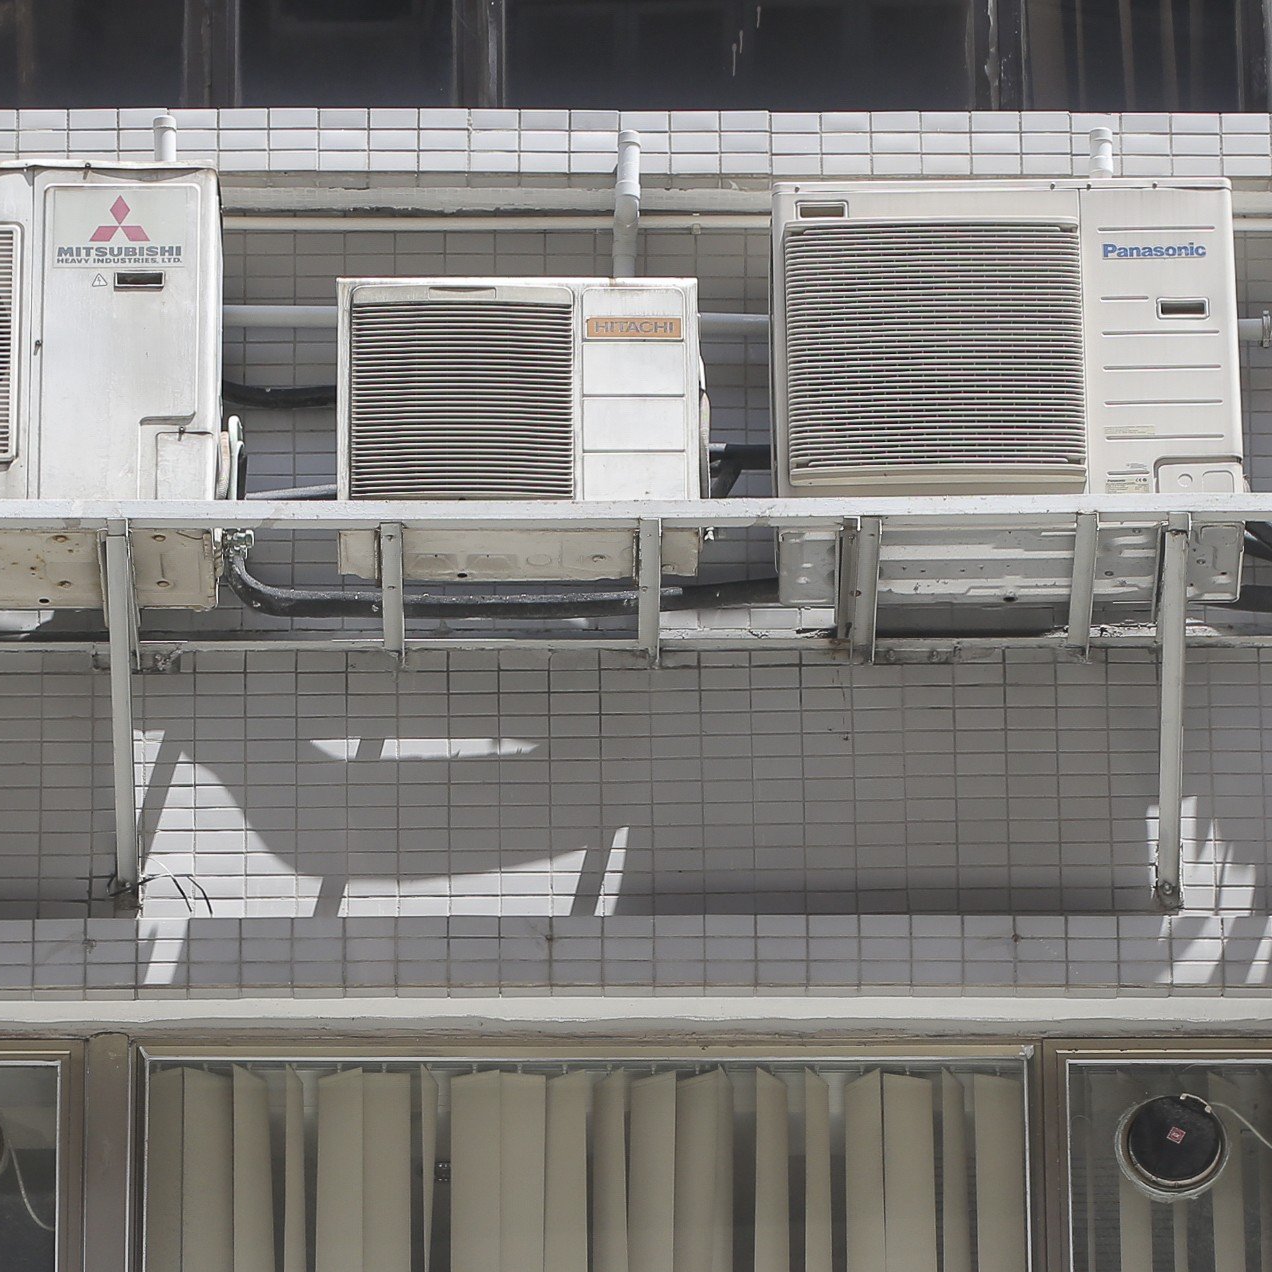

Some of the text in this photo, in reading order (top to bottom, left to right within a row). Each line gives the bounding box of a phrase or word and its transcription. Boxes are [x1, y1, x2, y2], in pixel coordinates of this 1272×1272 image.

[56, 246, 182, 257] MITSUBISHI
[1102, 242, 1207, 258] Panasonic
[595, 321, 674, 333] HITACHI
